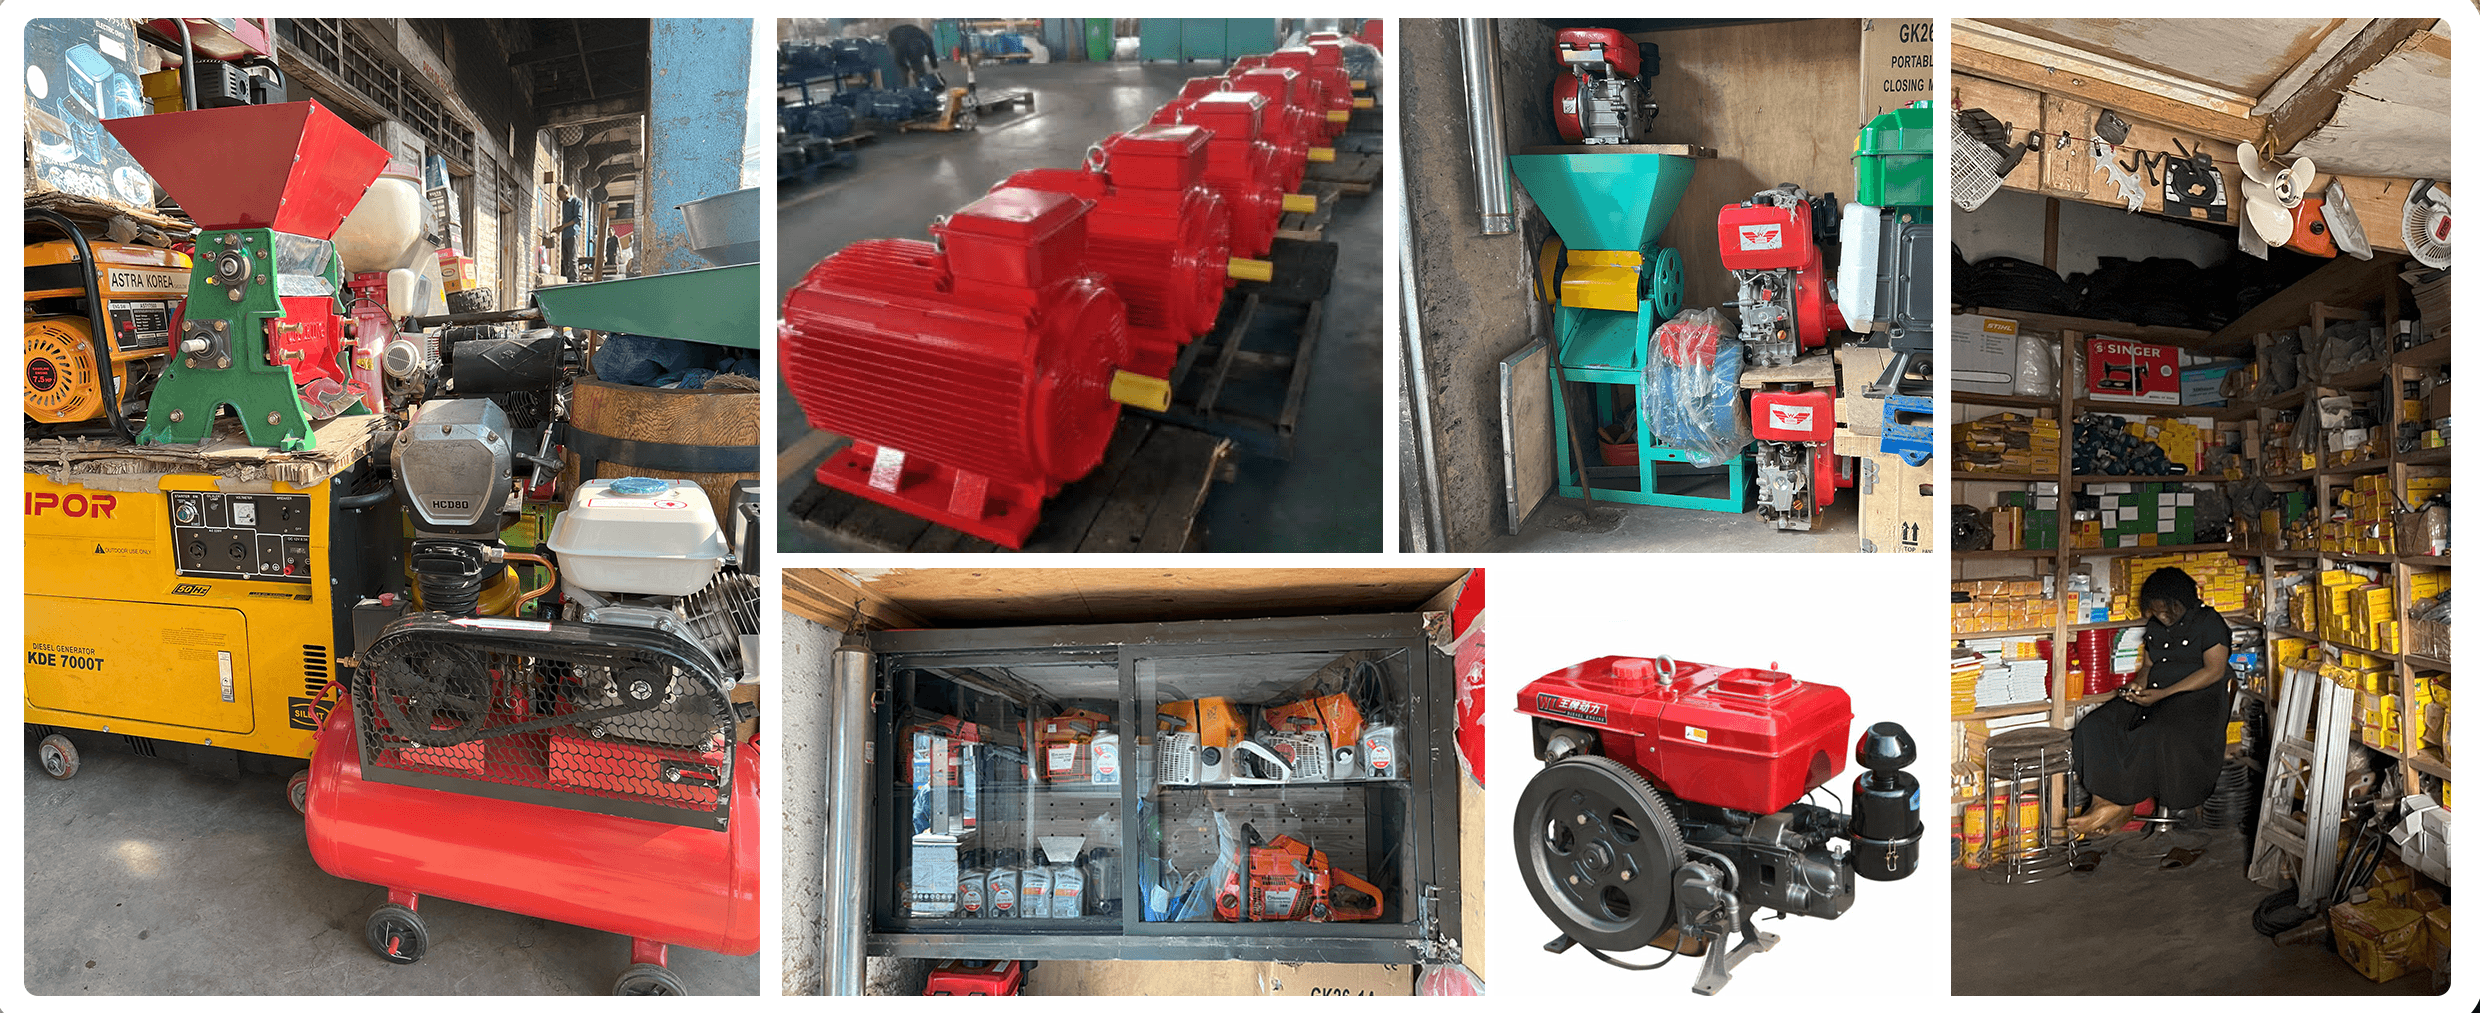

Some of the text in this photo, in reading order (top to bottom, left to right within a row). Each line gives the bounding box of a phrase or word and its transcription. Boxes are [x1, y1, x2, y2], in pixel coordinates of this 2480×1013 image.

[1883, 79, 1924, 92] CLOSING
[111, 272, 174, 289] ASTRA KOREA
[1987, 322, 2012, 331] STIHL
[2108, 344, 2160, 358] SINGER
[432, 500, 469, 509] HCD80
[33, 643, 95, 655] DIESEL GENERATOR
[28, 651, 104, 671] KDE 7000T
[1559, 698, 1600, 714] 王牌动力
[294, 709, 324, 719] SILT
